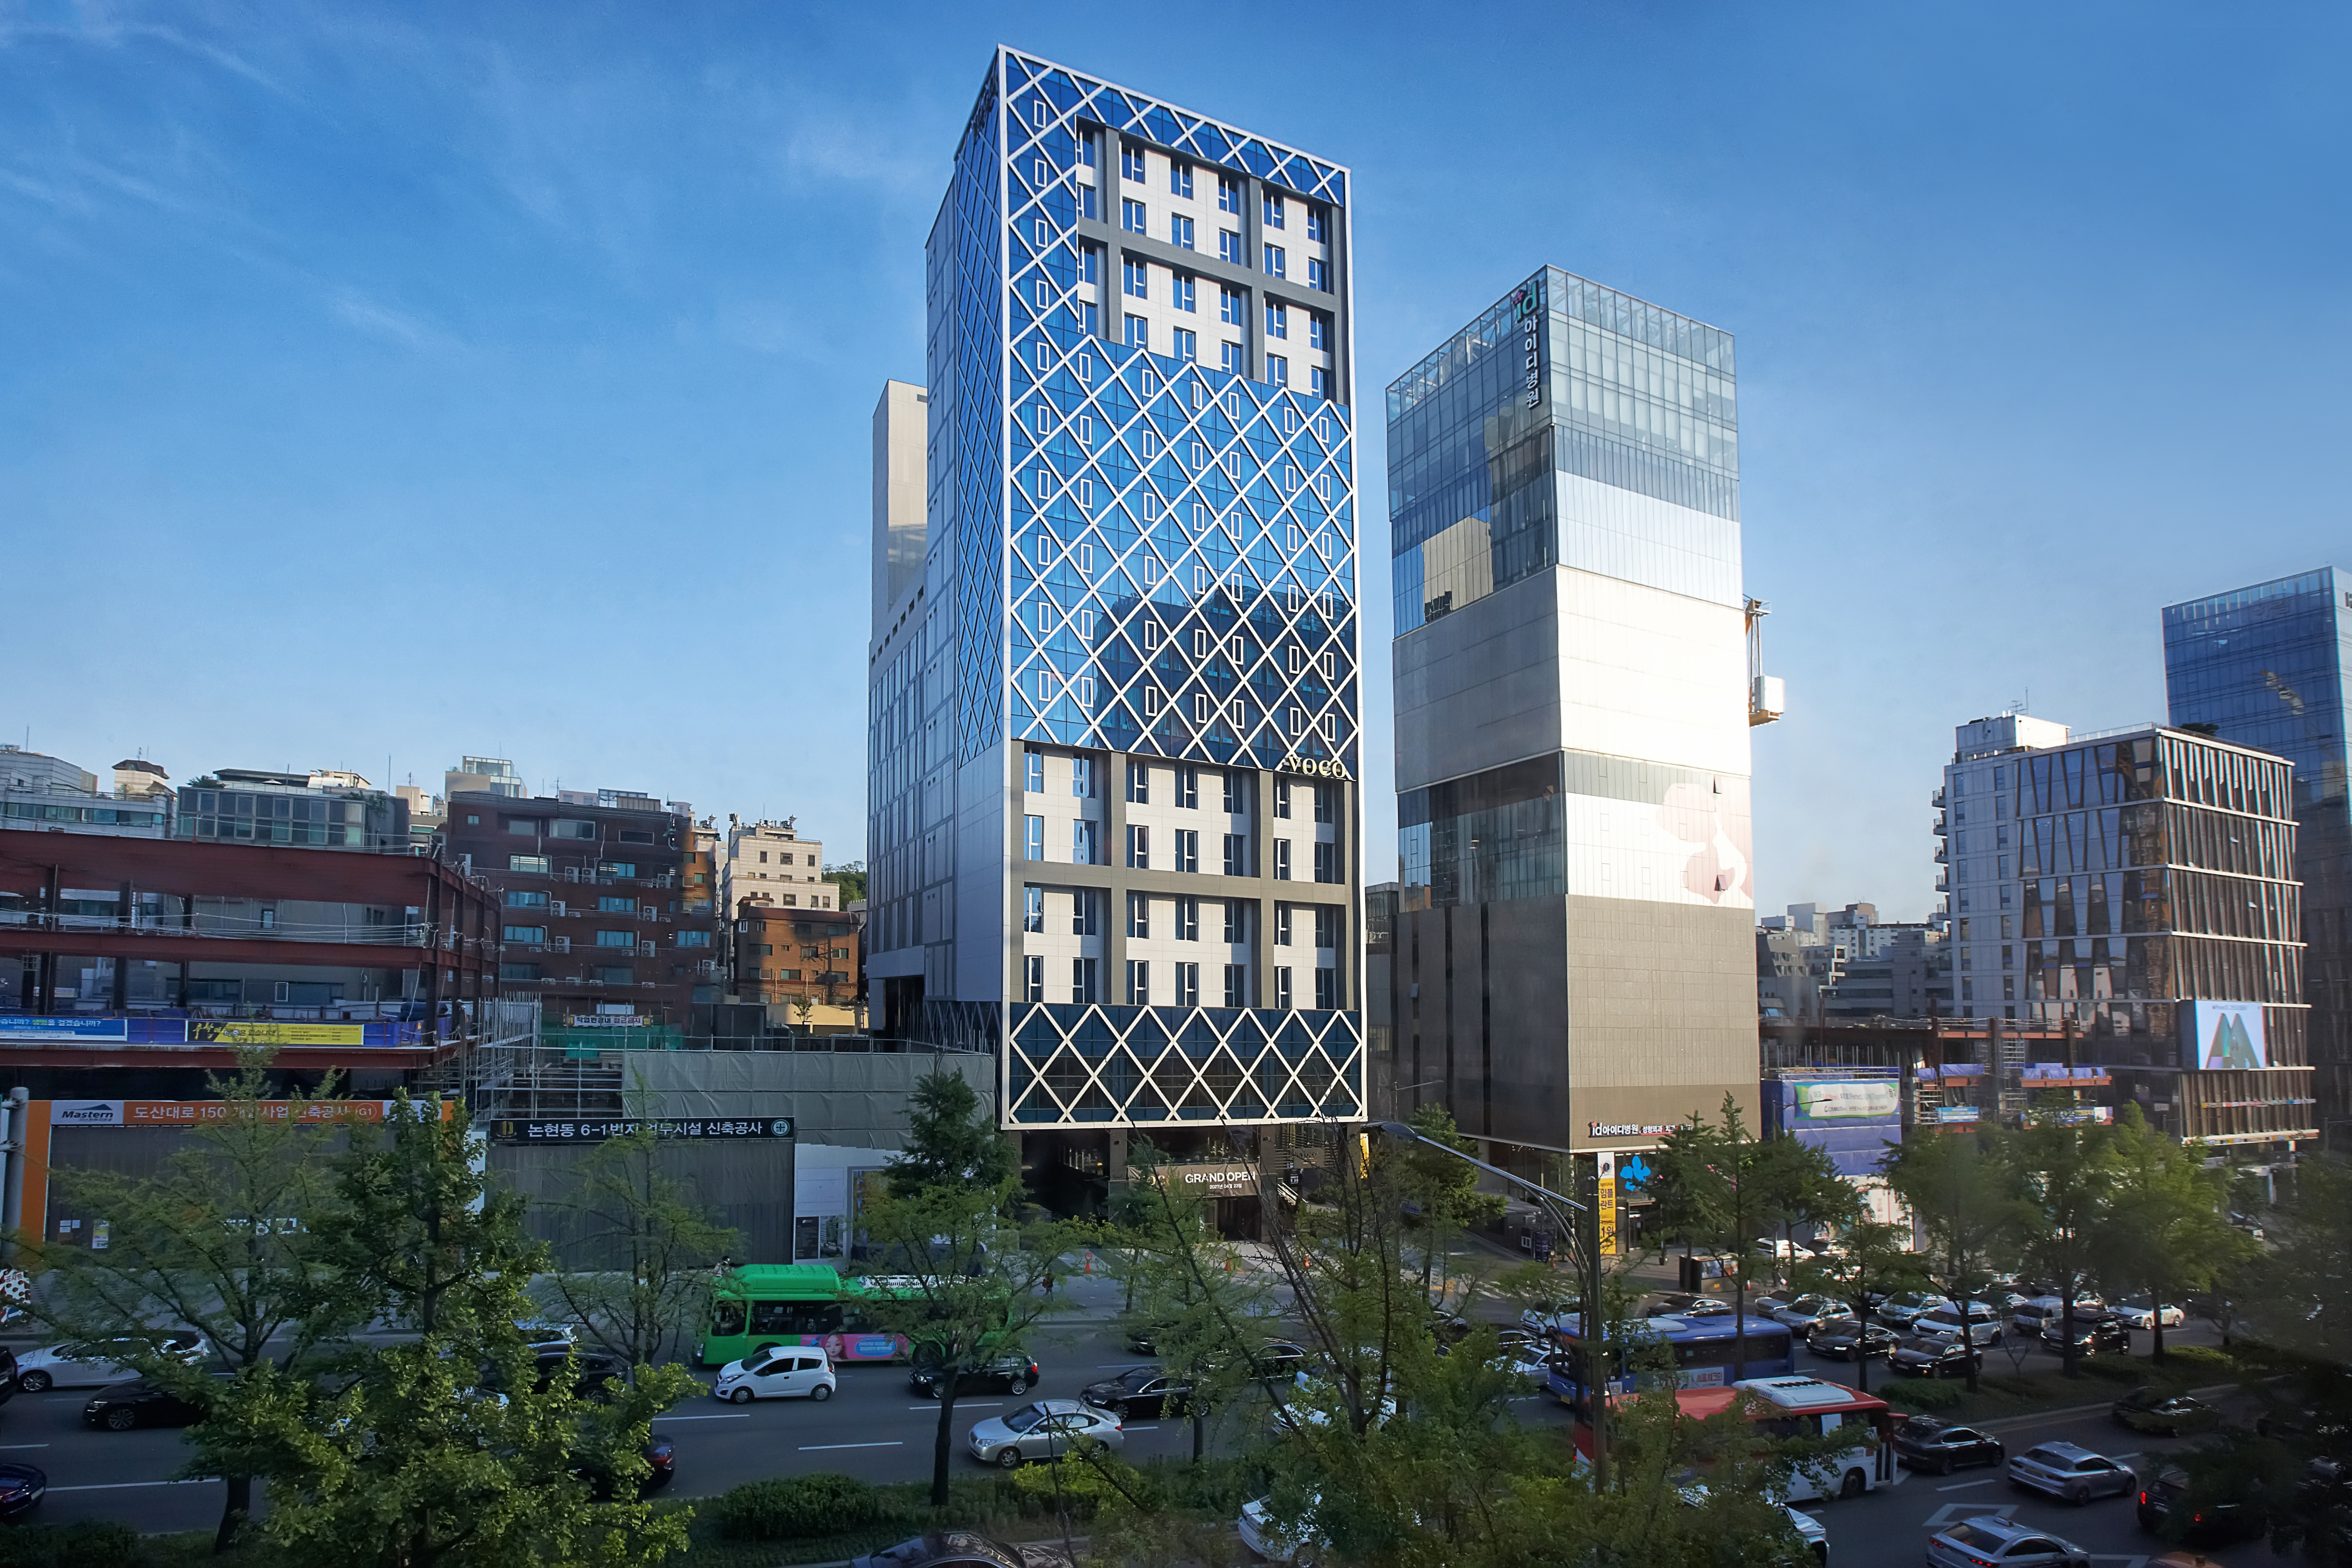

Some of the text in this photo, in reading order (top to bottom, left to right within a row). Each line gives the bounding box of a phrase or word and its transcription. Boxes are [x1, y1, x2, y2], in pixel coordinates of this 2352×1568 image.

[1525, 315, 1539, 408] 아이디병원
[133, 1106, 194, 1119] 도산대로
[200, 1106, 227, 1119] 150
[528, 1123, 575, 1137] 논현동
[707, 1121, 763, 1135] 신축공사
[1602, 1124, 1638, 1135] 아이디병원
[1642, 1125, 1663, 1134] 성형외과
[1185, 1171, 1256, 1183] GRAND OPEN
